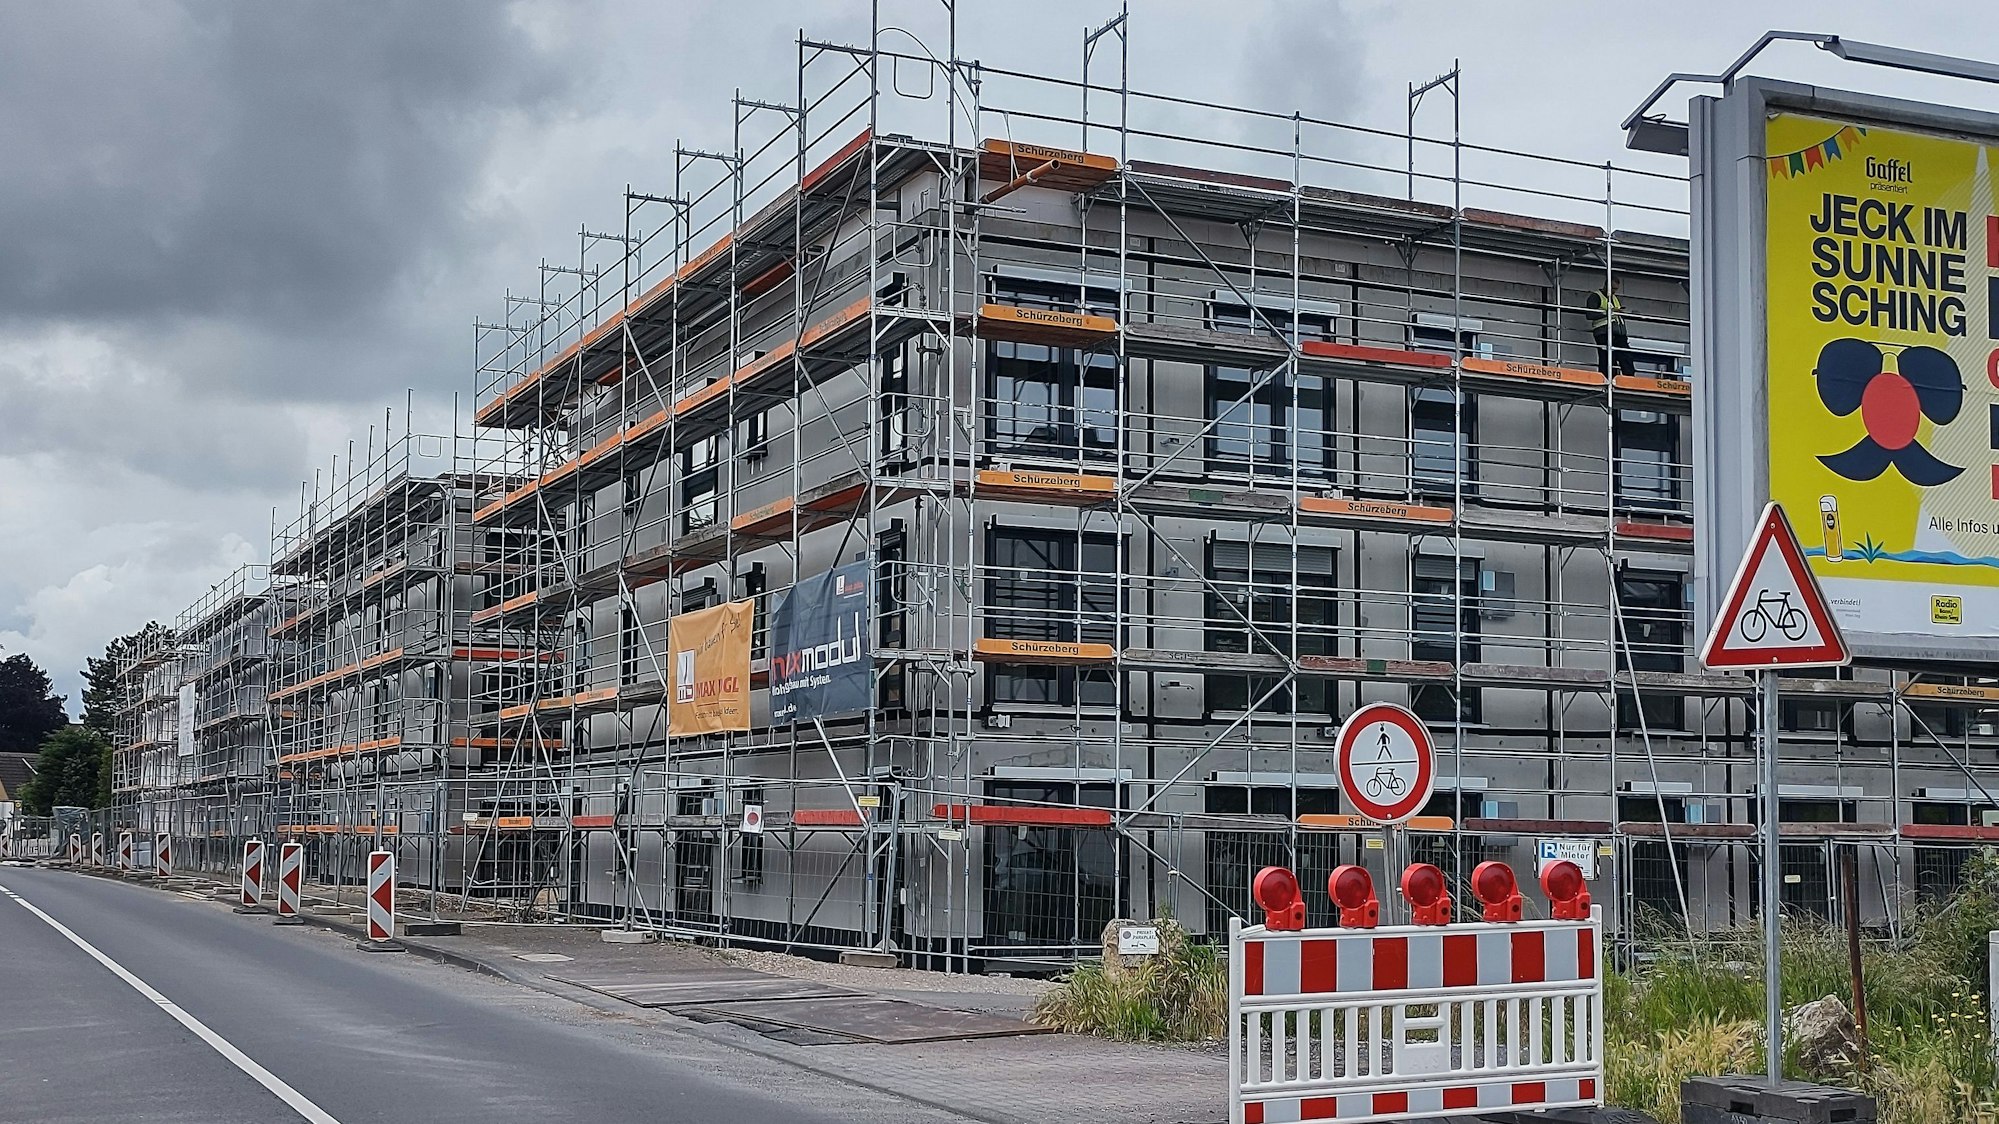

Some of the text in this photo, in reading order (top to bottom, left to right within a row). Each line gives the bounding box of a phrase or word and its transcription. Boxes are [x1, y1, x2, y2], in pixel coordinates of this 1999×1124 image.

[1018, 144, 1084, 163] Schürzeberg
[1866, 157, 1912, 183] Gaffel
[1870, 182, 1908, 194] präsentiert
[1810, 193, 1915, 244] JECK
[1924, 207, 1967, 251] IM
[1812, 237, 1967, 293] SUNNE
[1016, 309, 1083, 326] Schürzeberg
[1811, 282, 1967, 337] SCHING
[1506, 363, 1562, 379] Schürzeberg
[1013, 474, 1080, 487] Schürzeberg
[1347, 502, 1407, 517] Schürzeberg
[1929, 516, 1953, 531] Alle
[1957, 518, 1988, 534] Infos
[1935, 599, 1958, 609] Radio
[1012, 642, 1079, 655] Schürzeberg
[696, 680, 716, 698] MAX
[1937, 686, 1985, 698] Schürzeberg
[1559, 843, 1576, 851] Nur
[1577, 843, 1592, 852] für
[1560, 851, 1590, 860] Mieter
